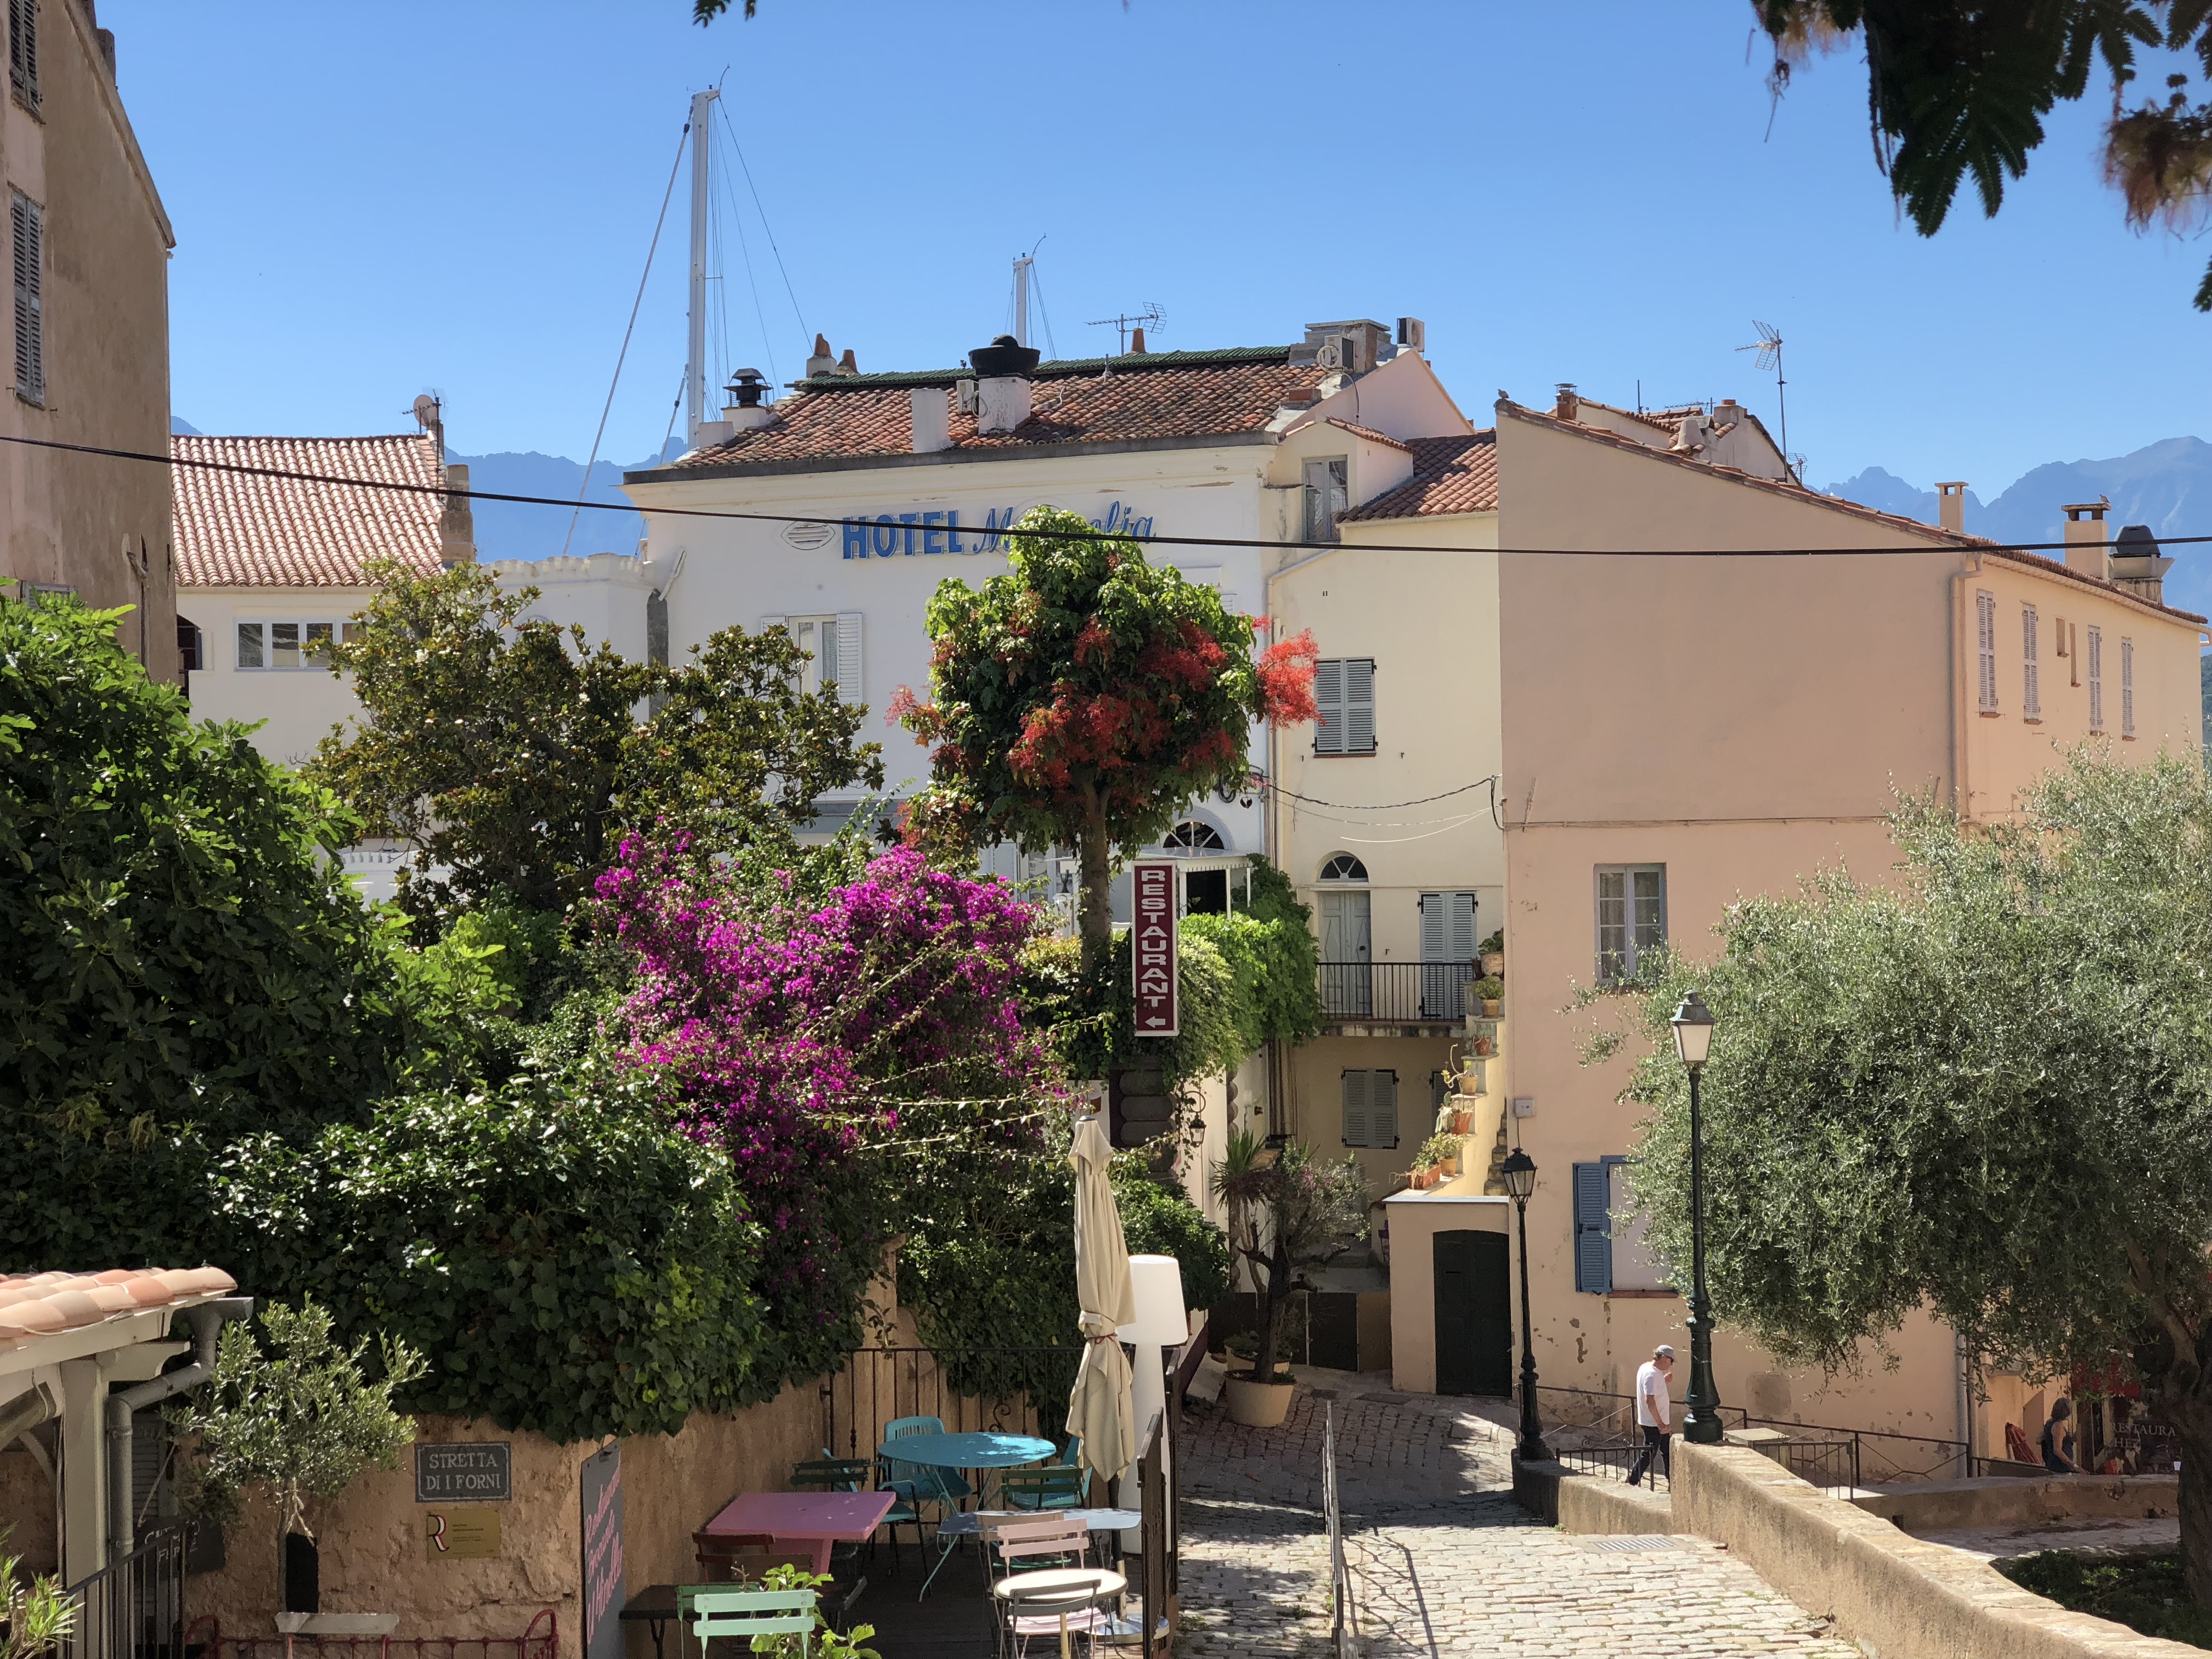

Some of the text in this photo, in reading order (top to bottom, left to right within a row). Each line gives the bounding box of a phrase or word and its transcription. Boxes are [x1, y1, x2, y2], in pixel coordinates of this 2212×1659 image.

[842, 510, 964, 560] HOTEL
[1140, 870, 1169, 1008] RESTAURANT
[429, 1452, 499, 1469] STRETTA
[426, 1472, 501, 1490] DI I FORNI
